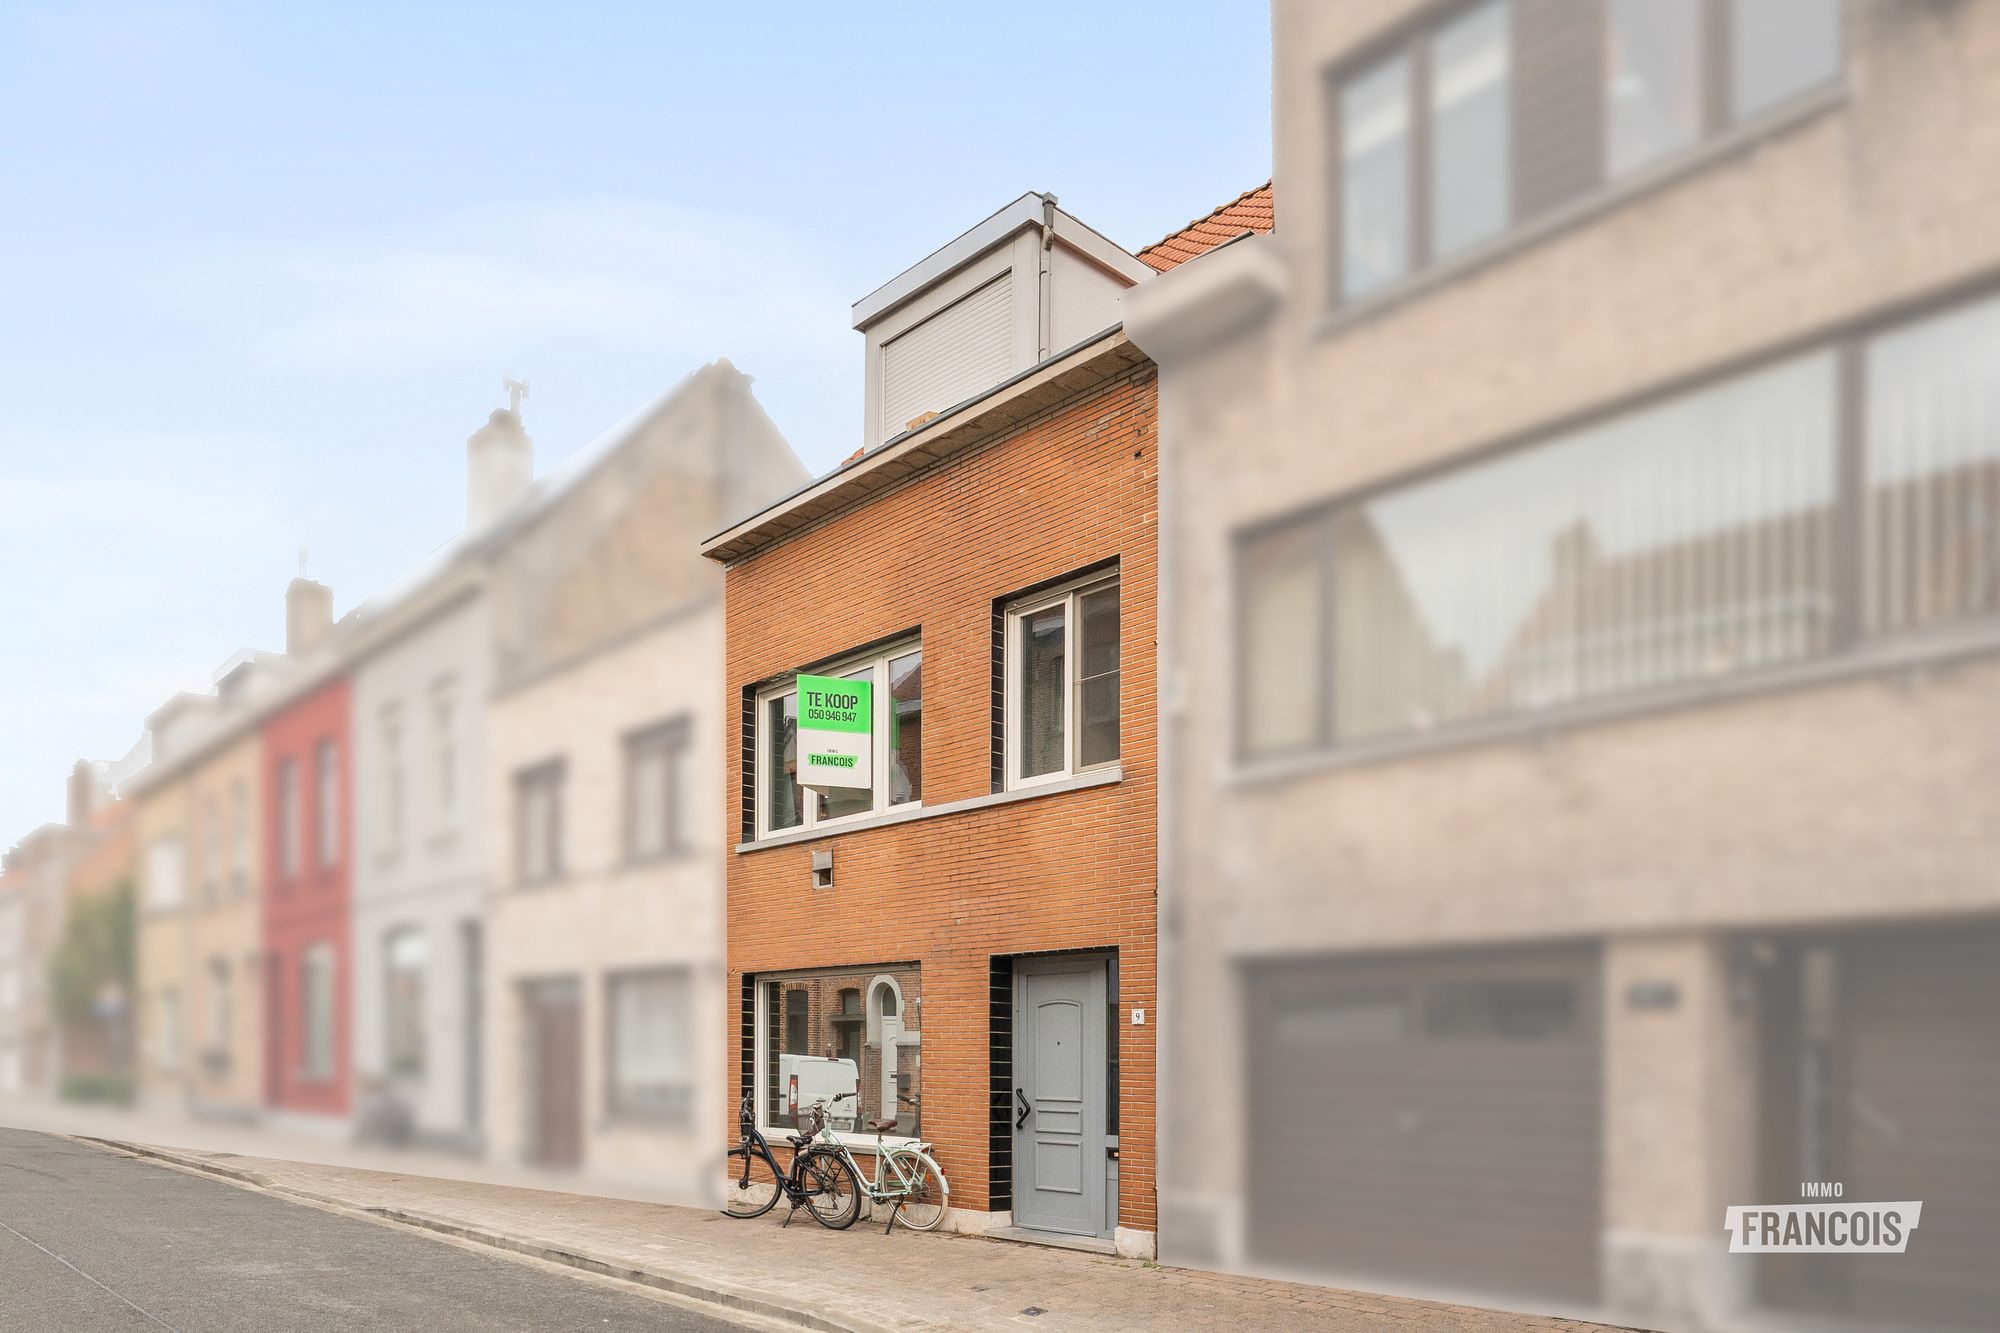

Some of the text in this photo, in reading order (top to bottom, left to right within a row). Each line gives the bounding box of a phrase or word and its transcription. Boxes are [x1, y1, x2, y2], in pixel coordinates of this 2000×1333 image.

[807, 691, 858, 710] TE KOOP
[808, 709, 857, 722] 050 946 947
[811, 755, 853, 768] FRANCOIS
[1135, 1012, 1140, 1021] 9
